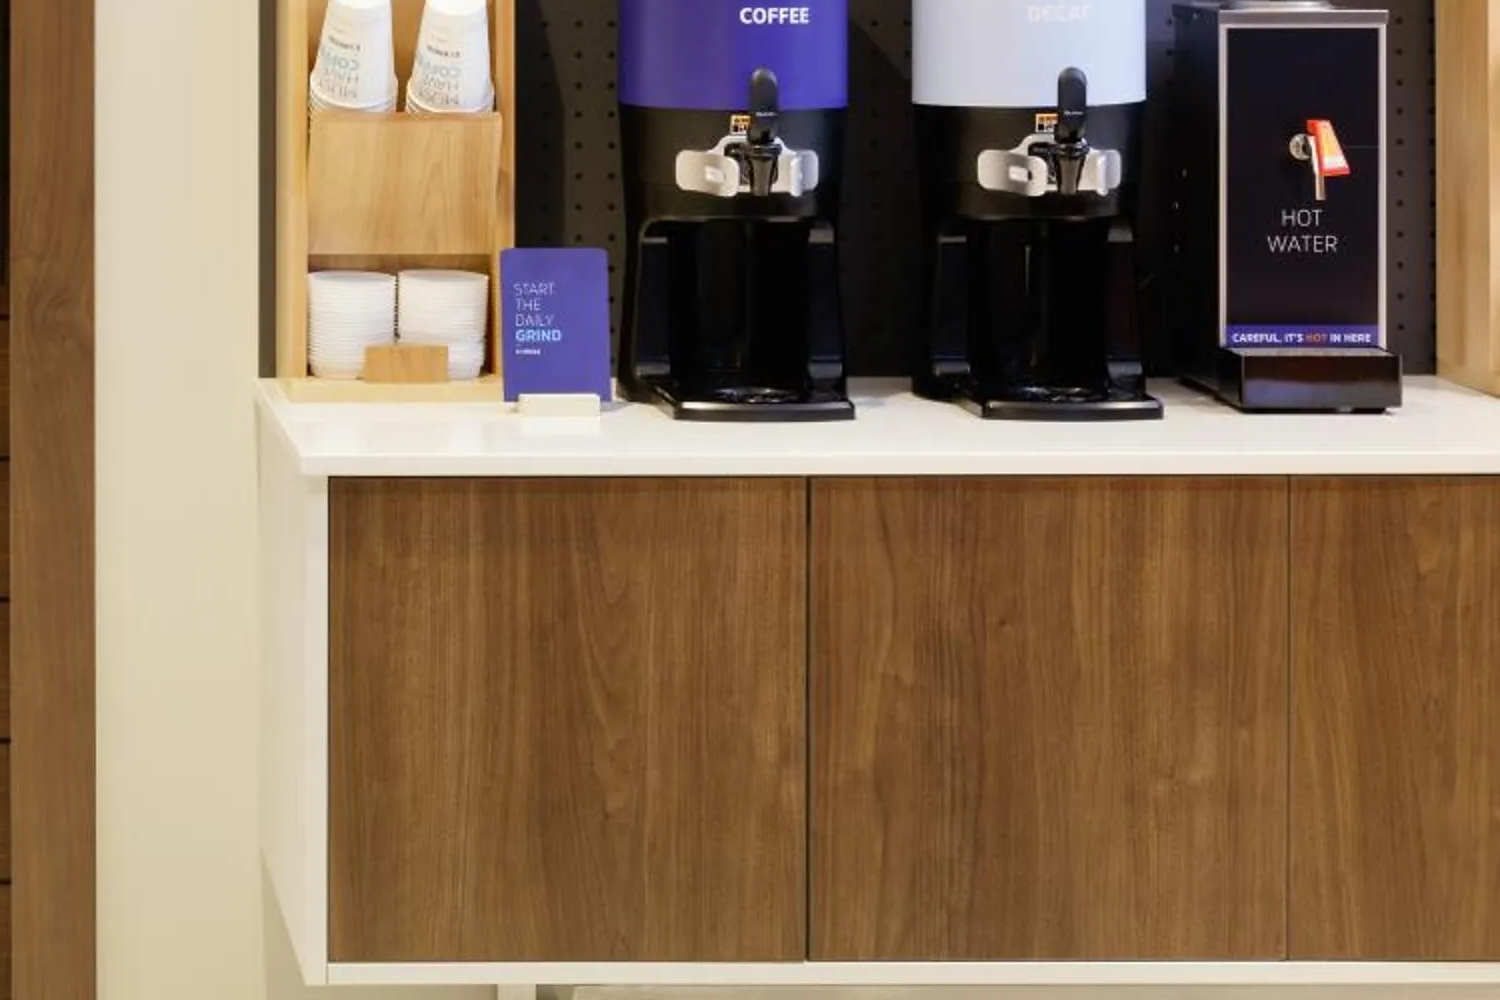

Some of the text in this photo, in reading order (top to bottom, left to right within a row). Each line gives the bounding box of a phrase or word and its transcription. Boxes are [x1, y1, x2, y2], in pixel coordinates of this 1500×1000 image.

[739, 7, 810, 25] COFFEE
[1027, 4, 1093, 24] DECAF
[1280, 209, 1324, 228] HOT
[1266, 235, 1339, 253] WATER
[513, 281, 556, 296] START
[515, 298, 542, 311] THE
[515, 313, 556, 327] DAILY
[515, 329, 562, 342] GRIND
[1284, 332, 1303, 344] IT'S
[1330, 333, 1342, 343] IN
[1343, 333, 1372, 344] HERE
